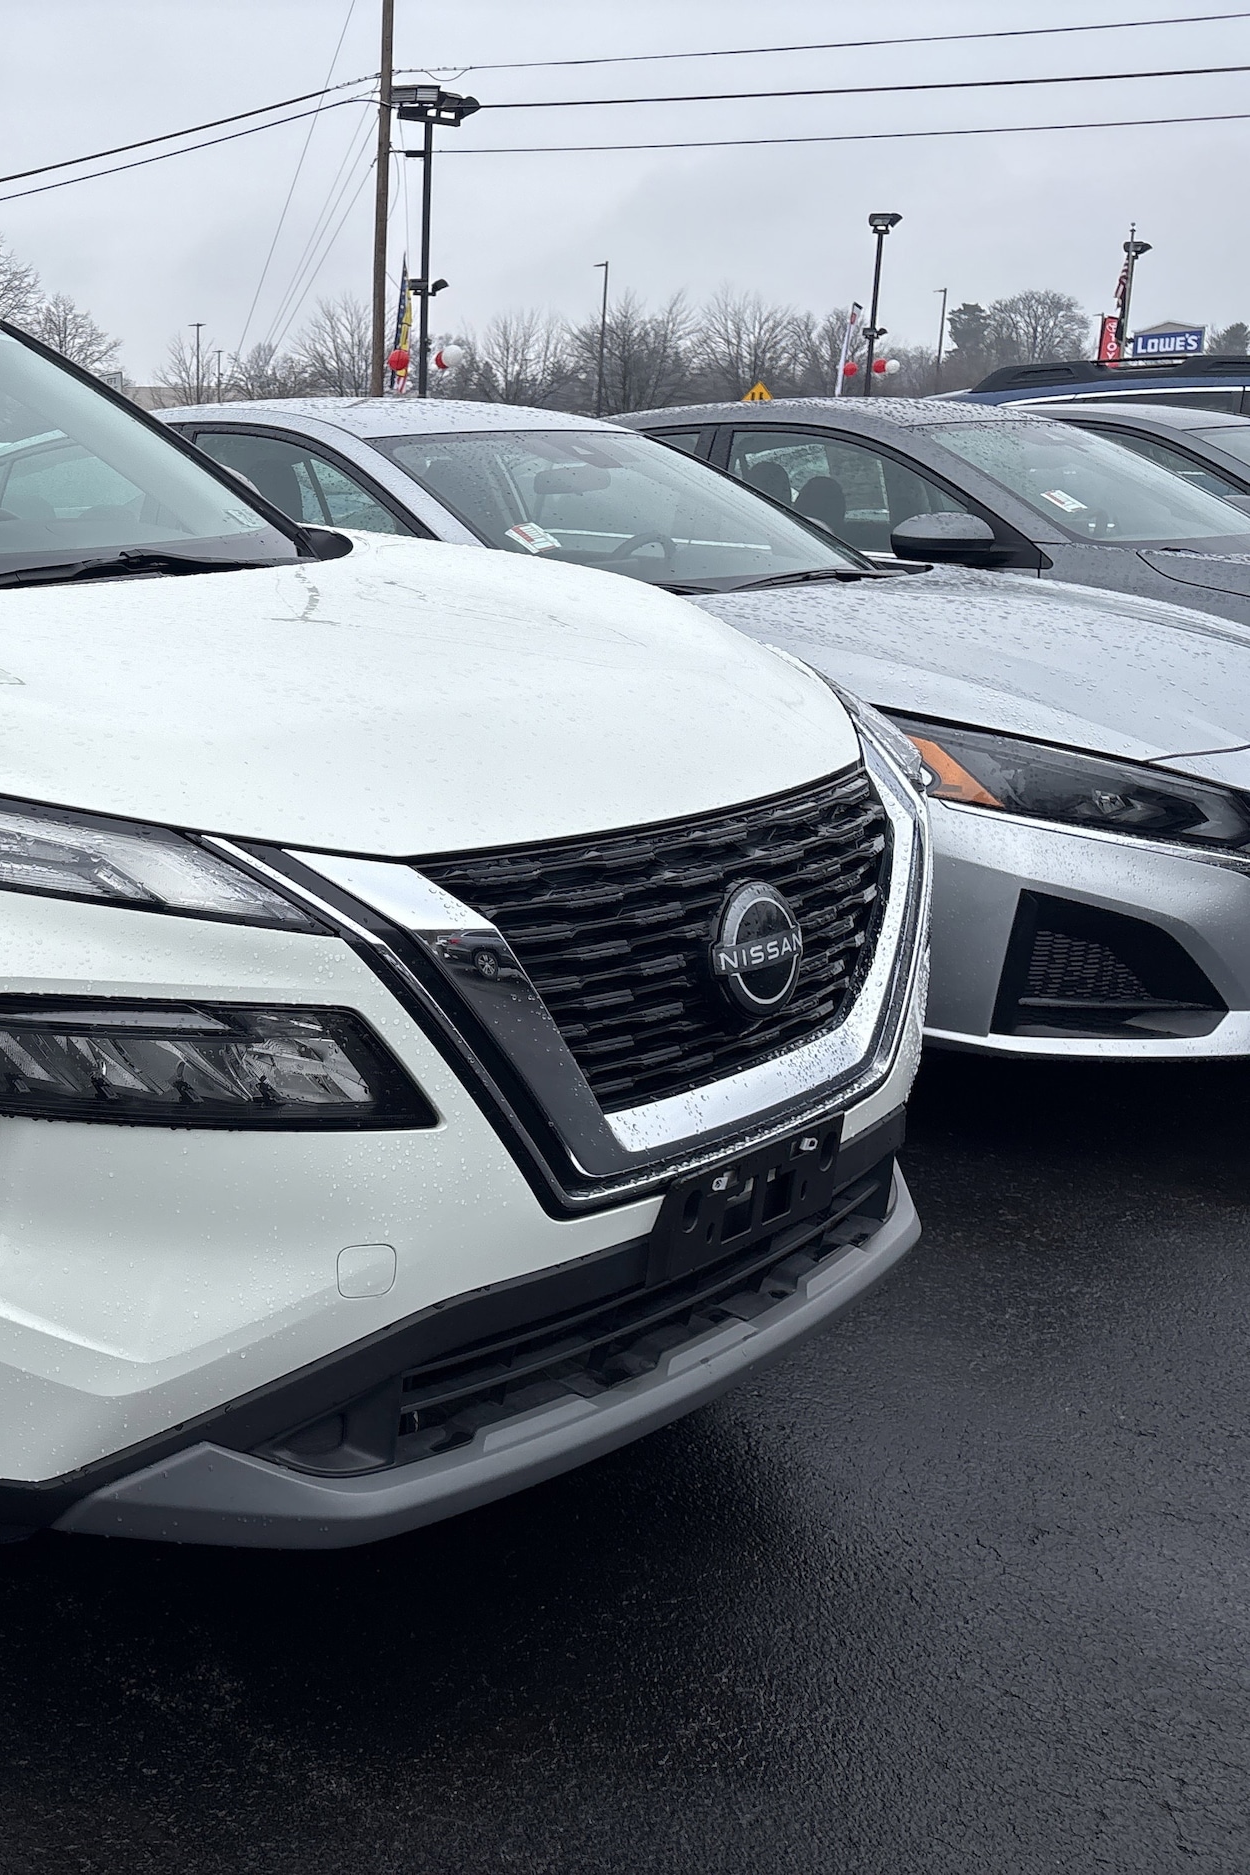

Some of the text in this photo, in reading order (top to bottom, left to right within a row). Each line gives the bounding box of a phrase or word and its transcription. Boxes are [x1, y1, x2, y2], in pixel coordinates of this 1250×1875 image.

[1105, 332, 1117, 366] TOY
[1137, 332, 1198, 354] LOWE'S
[718, 933, 802, 971] NISSAN
